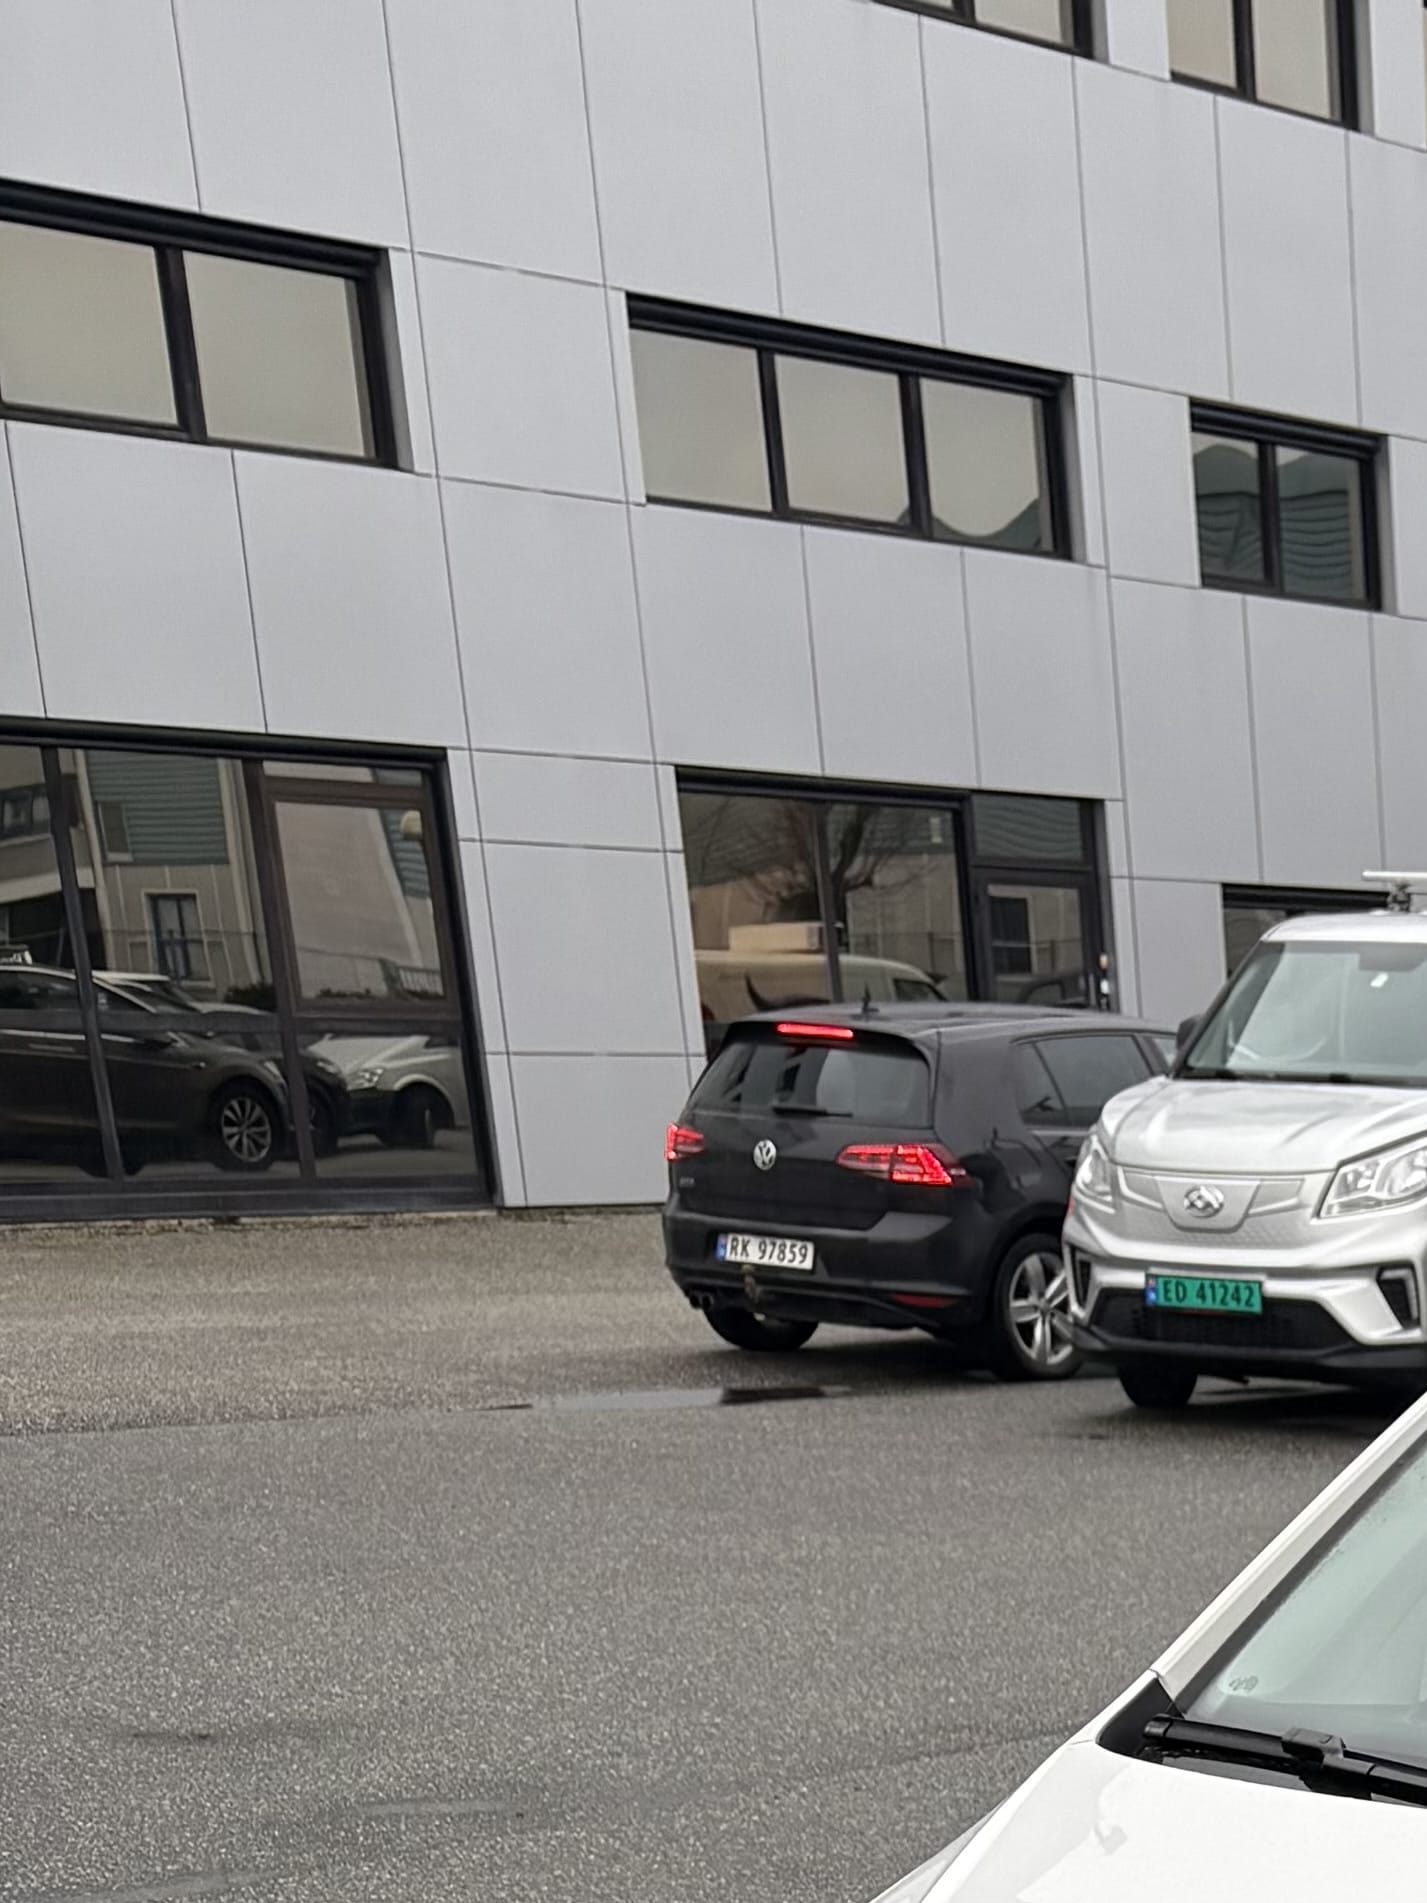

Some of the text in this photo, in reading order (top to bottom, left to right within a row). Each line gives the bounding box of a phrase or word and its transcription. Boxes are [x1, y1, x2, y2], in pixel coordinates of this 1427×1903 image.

[729, 1236, 808, 1265] RK 97859
[1196, 1281, 1256, 1308] 41242
